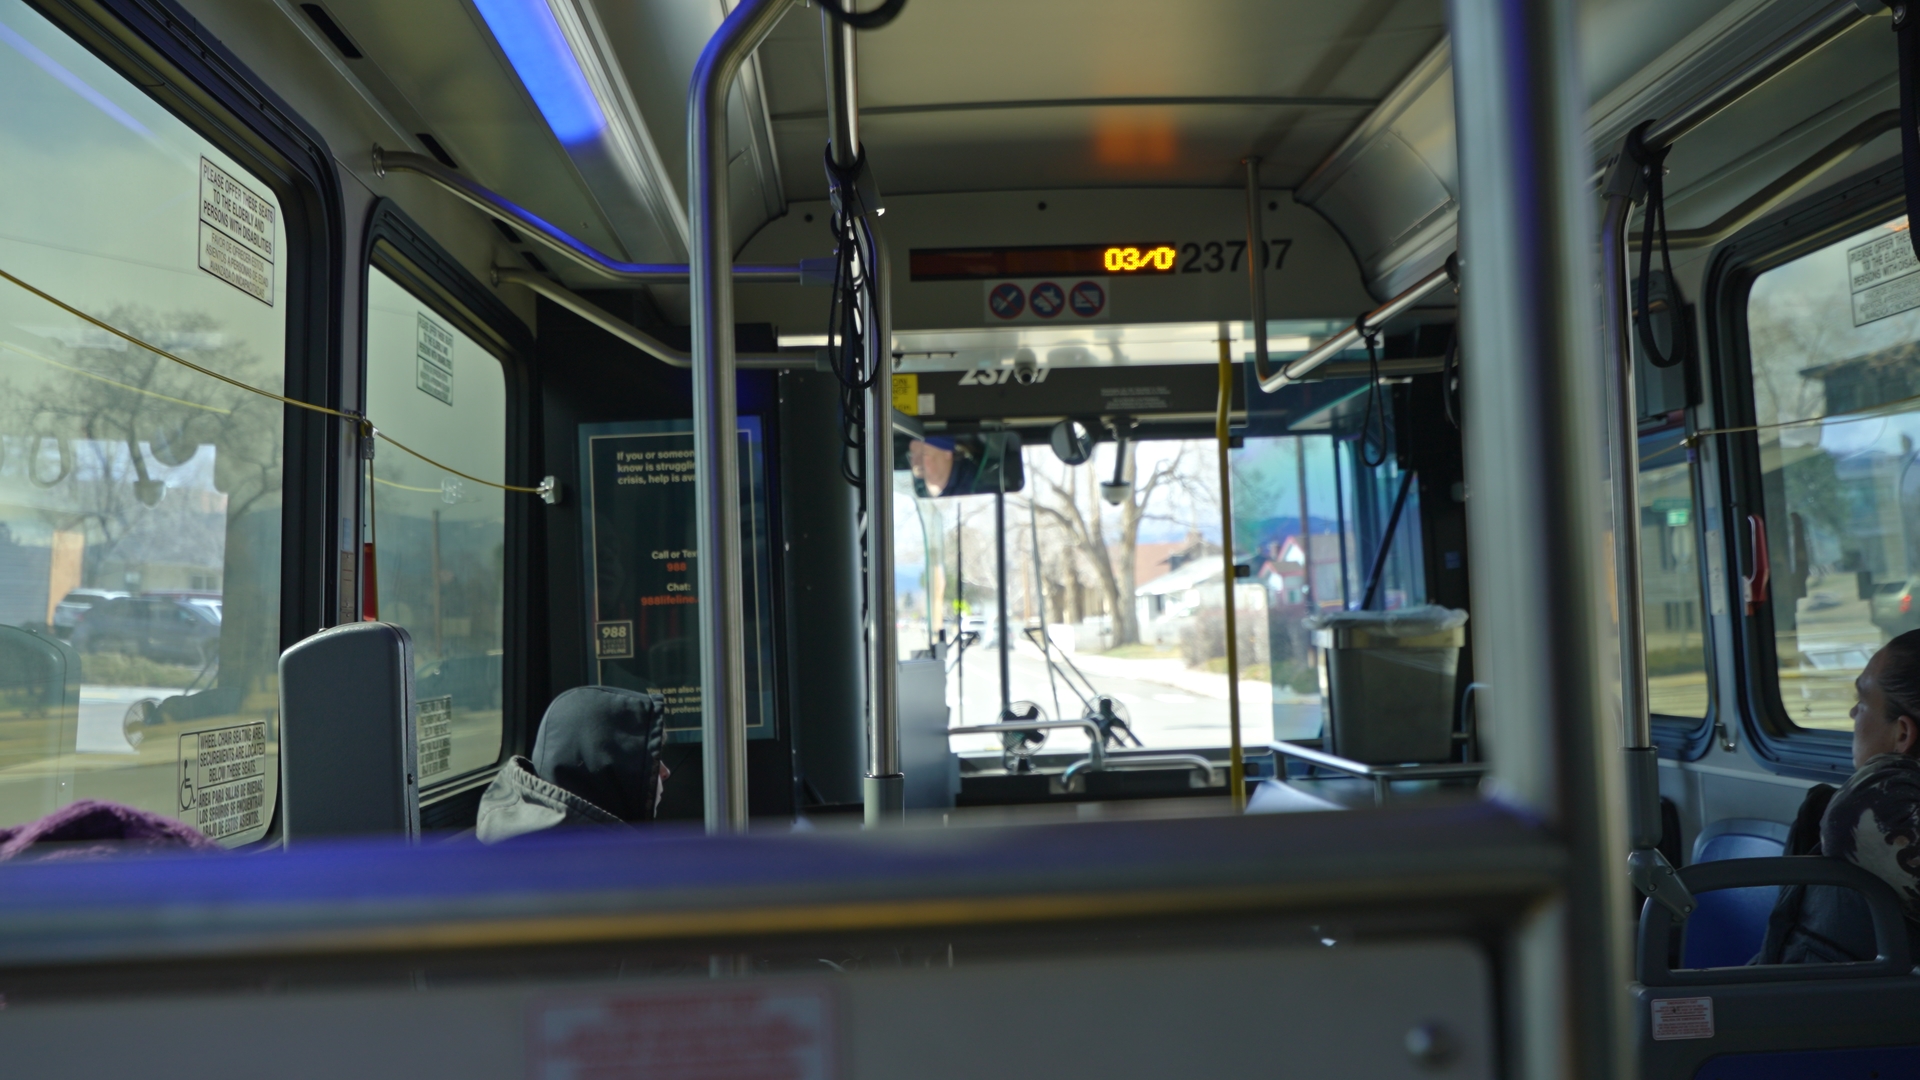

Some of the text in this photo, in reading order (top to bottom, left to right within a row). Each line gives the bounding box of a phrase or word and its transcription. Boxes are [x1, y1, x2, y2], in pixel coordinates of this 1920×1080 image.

[203, 164, 273, 224] PLEASE OFFER THESE SEATS
[213, 188, 264, 235] TO THE ELDERLY AND
[203, 199, 271, 256] PERSONS WITH DISABILITIES
[1895, 232, 1910, 246] THES
[1105, 247, 1176, 271] 03/0
[1898, 255, 1918, 270] DISAB
[617, 450, 695, 462] If you or someon
[617, 462, 643, 472] know
[646, 461, 653, 471] is
[617, 475, 646, 485] crisis,
[648, 473, 669, 484] help
[671, 472, 680, 482] is
[652, 549, 698, 559] Call or Tex
[667, 562, 687, 572] 988
[667, 583, 691, 592] Chat:
[602, 626, 627, 638] 988
[678, 685, 695, 693] also
[200, 733, 216, 749] WHEEL
[218, 731, 232, 746] CHAIR
[232, 728, 251, 743] SEATING
[199, 741, 264, 767] SECUREMENTS ARE LOCATED
[209, 765, 225, 782] BELOW
[226, 762, 240, 778] THESE
[212, 788, 223, 804] PARA
[225, 784, 239, 801] SILLAS
[240, 782, 245, 797] DE
[199, 808, 208, 824] LOS
[230, 801, 235, 815] SE
[218, 819, 223, 835] DE
[224, 815, 238, 833] ESTOS
